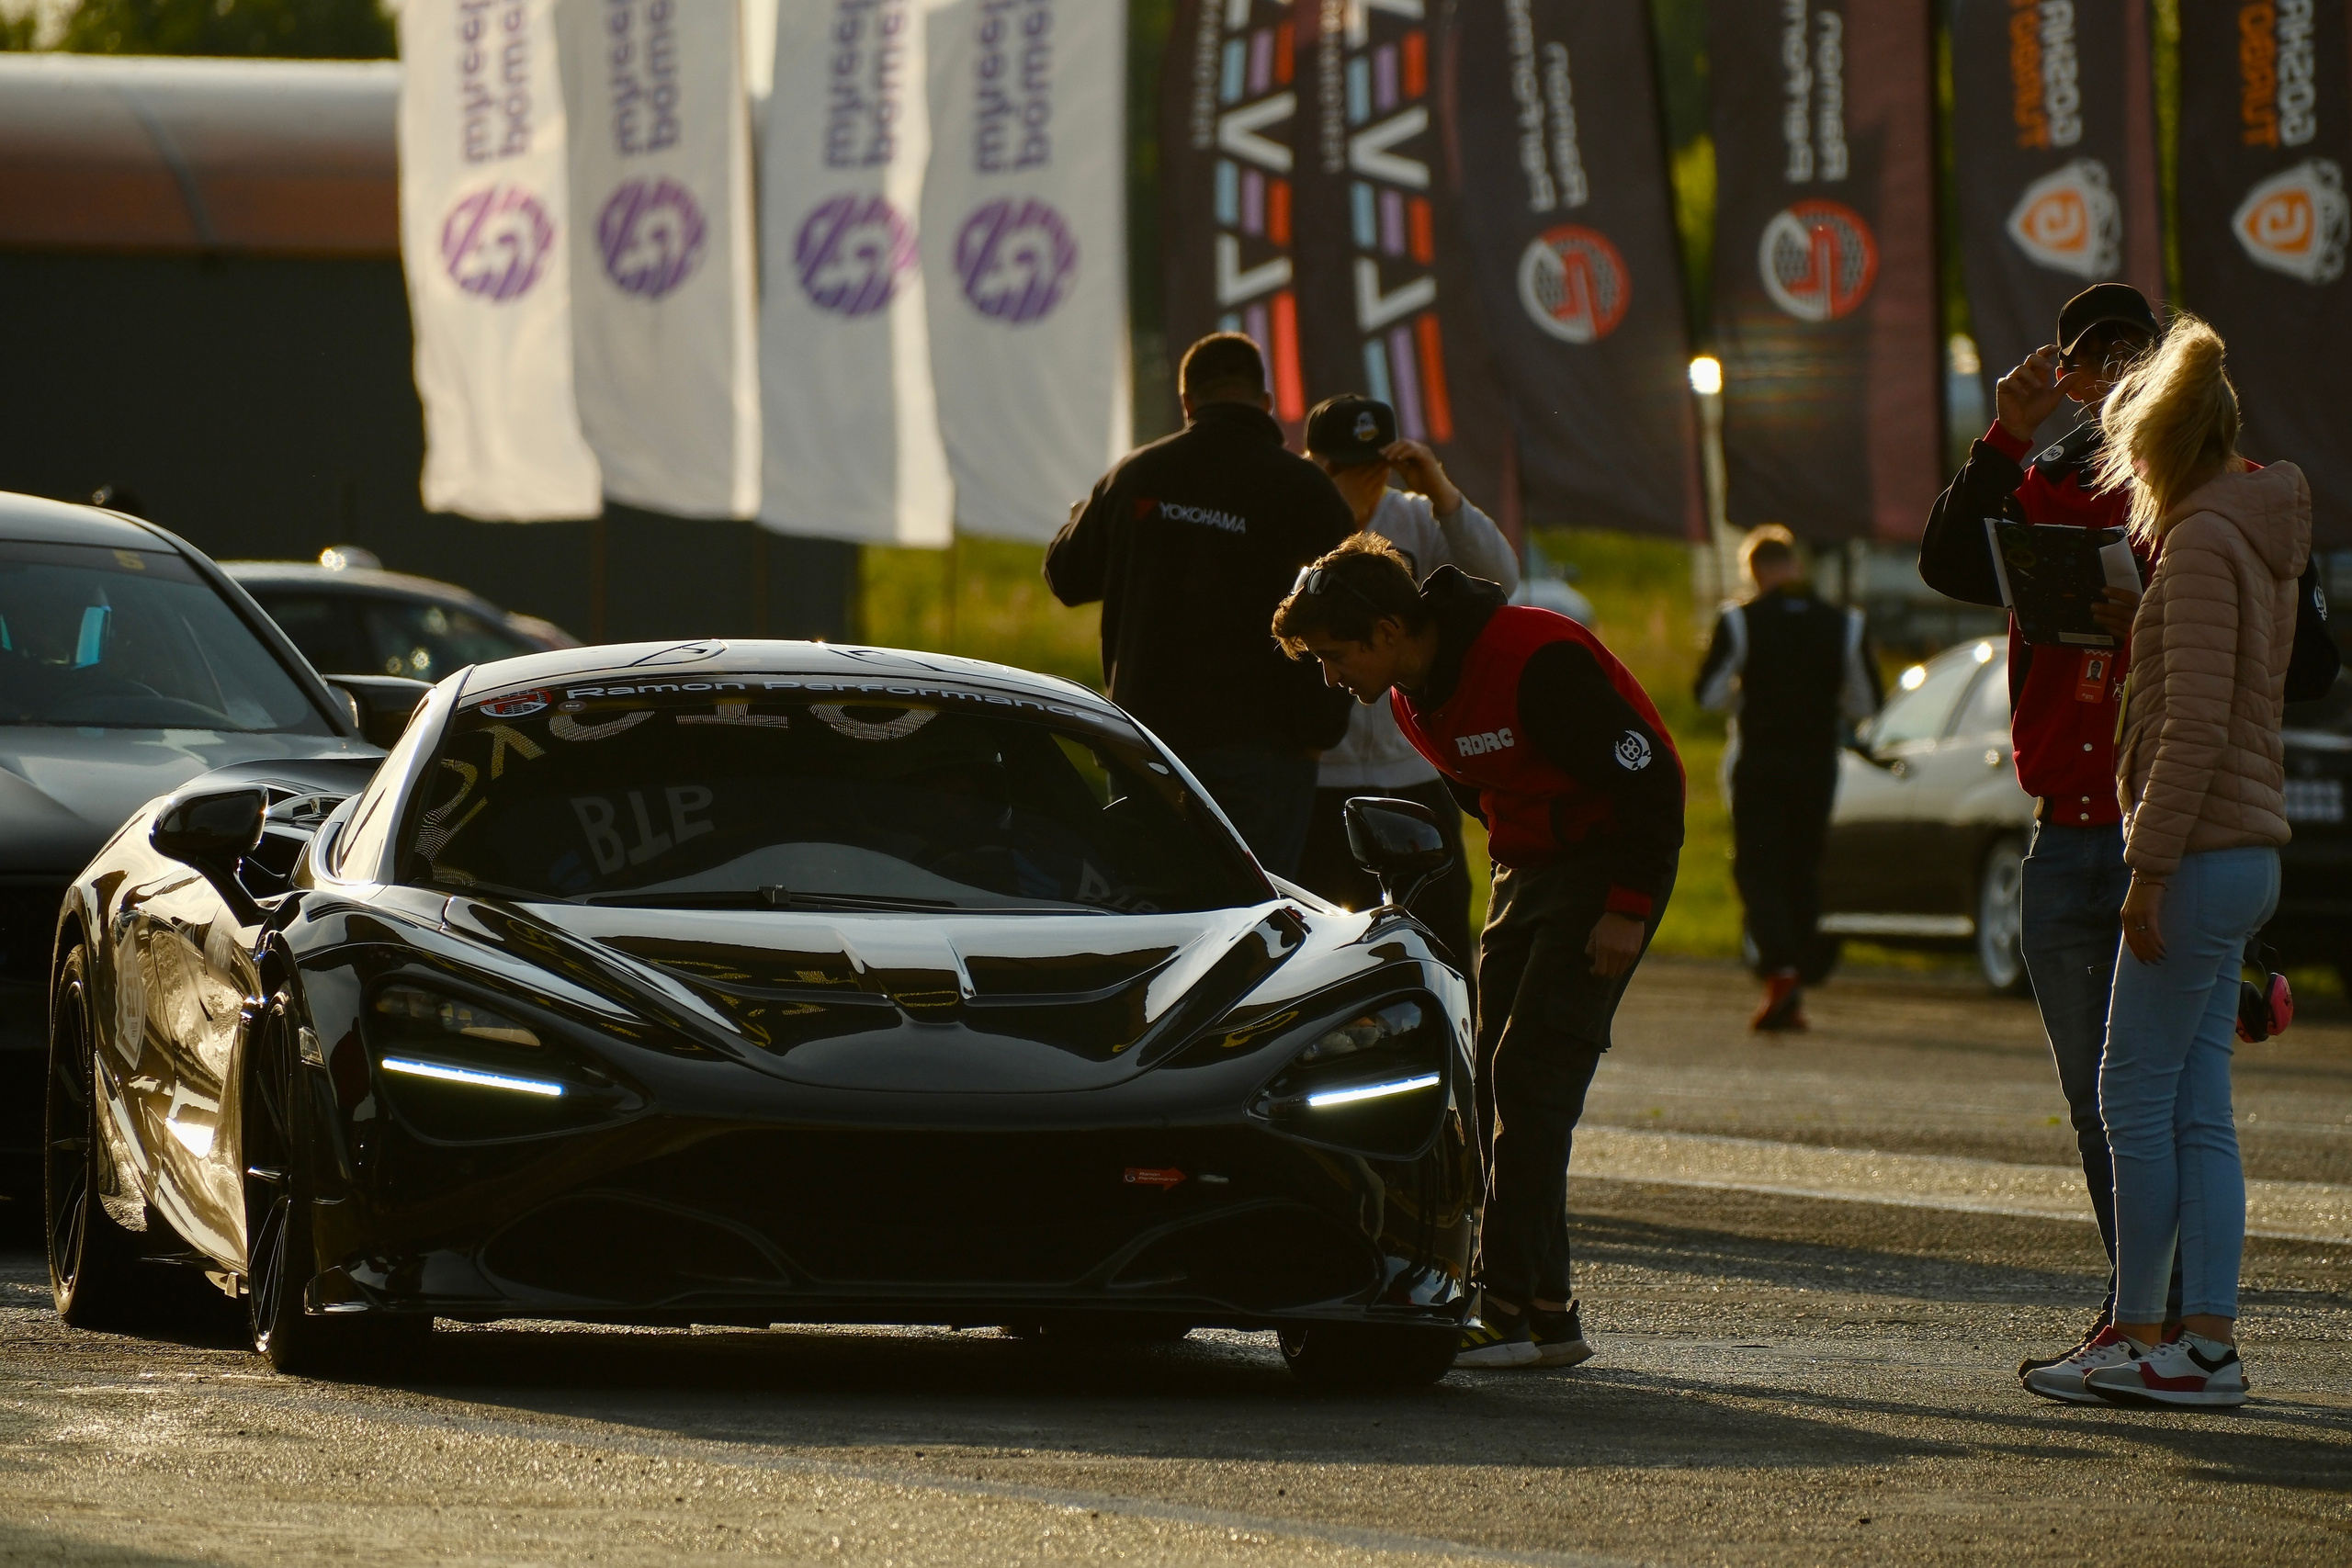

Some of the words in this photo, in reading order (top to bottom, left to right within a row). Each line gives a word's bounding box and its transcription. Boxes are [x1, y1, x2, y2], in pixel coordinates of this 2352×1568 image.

[1159, 501, 1247, 535] YOKOHAMA
[566, 681, 745, 699] Ramon
[763, 680, 1103, 724] Performance
[1455, 728, 1515, 757] RDRC
